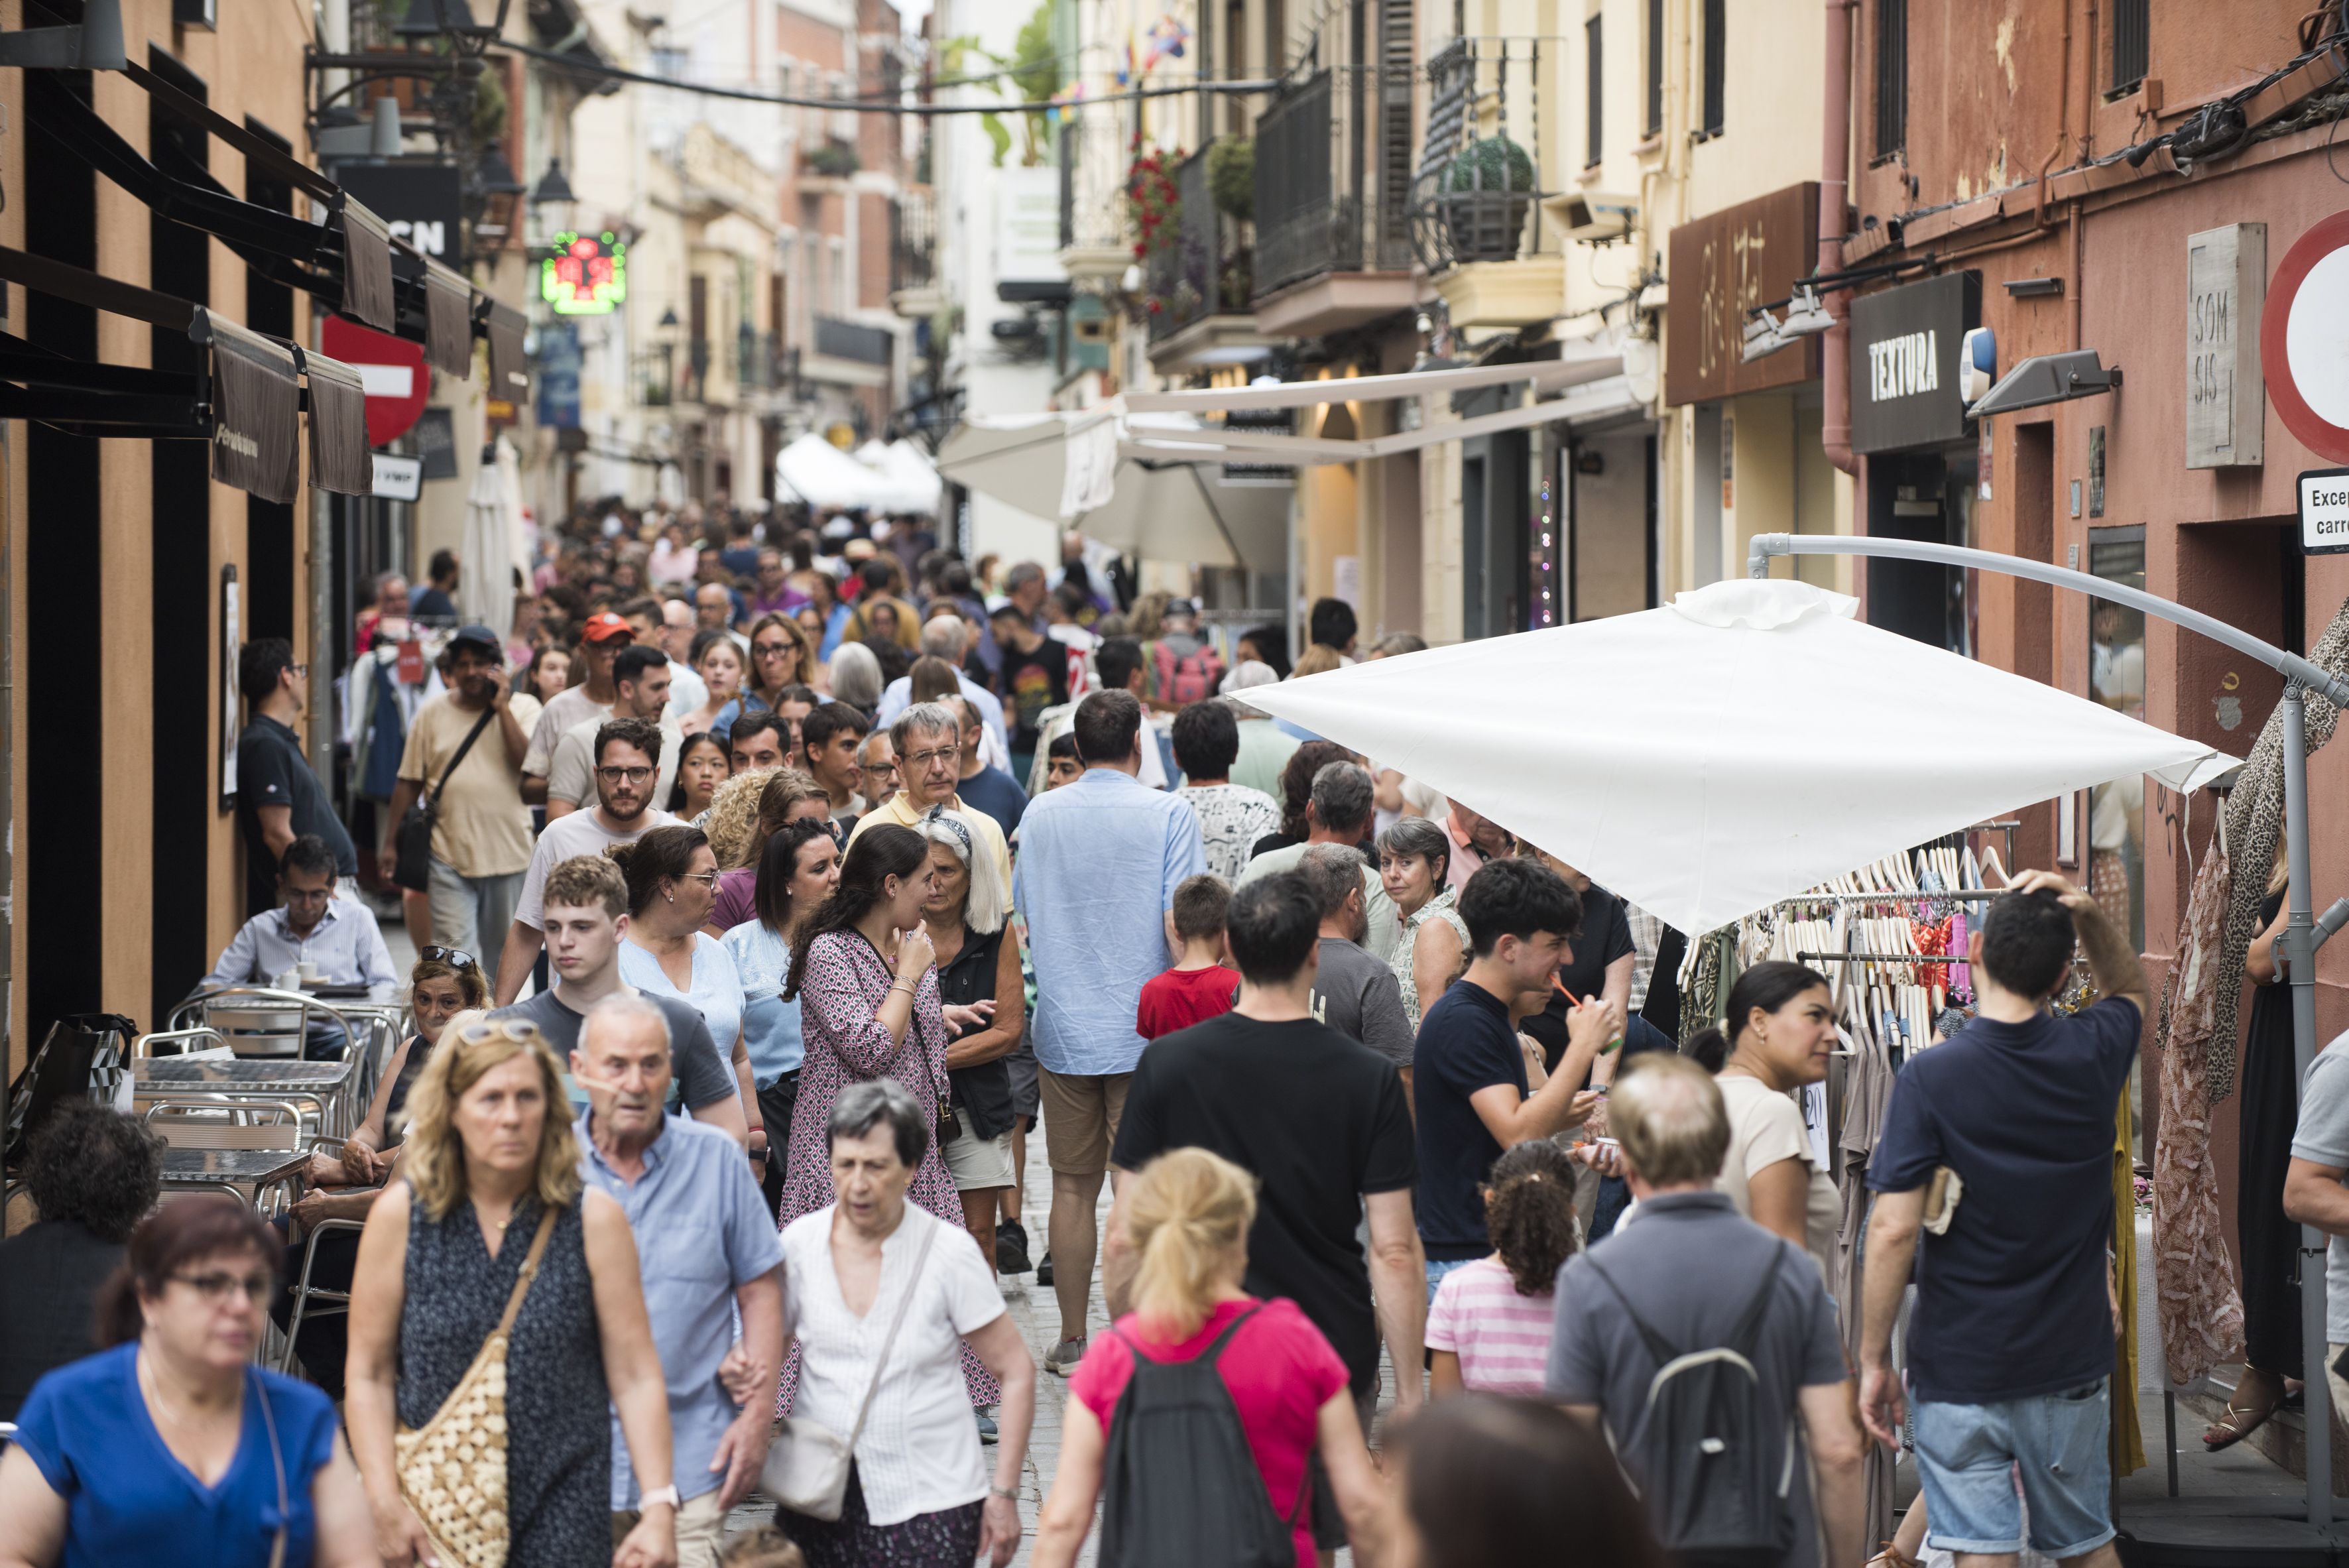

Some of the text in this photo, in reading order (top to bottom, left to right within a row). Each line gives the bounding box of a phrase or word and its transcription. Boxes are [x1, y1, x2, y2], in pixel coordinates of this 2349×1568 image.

[2196, 290, 2227, 342] SOM
[1869, 330, 1937, 402] TEXTURA
[2195, 353, 2216, 405] SIS
[2313, 489, 2349, 508] Exce
[2317, 519, 2349, 534] carr
